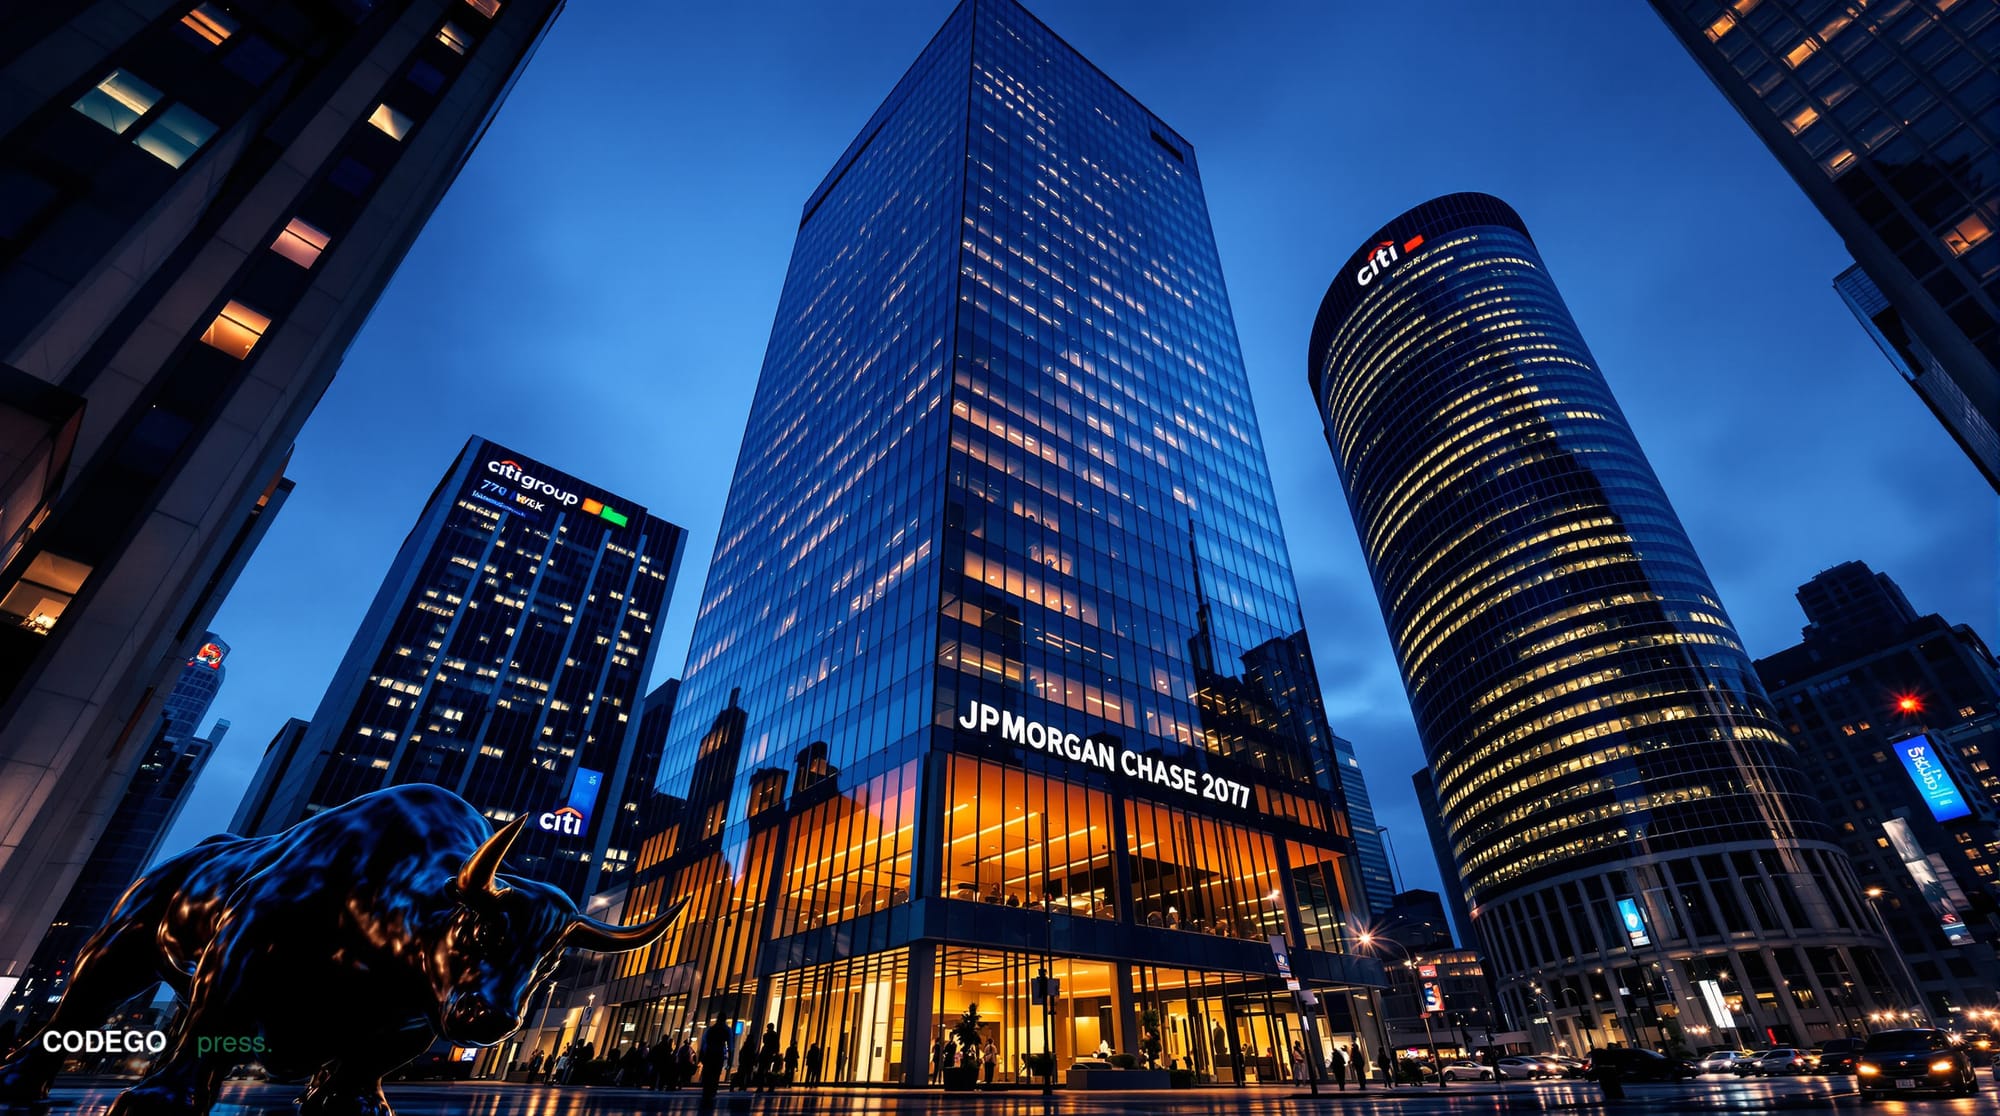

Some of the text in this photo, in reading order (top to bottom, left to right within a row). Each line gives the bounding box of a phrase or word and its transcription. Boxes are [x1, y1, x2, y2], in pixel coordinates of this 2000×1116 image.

[1357, 241, 1398, 286] citi
[487, 460, 579, 506] citigroup
[959, 700, 1250, 809] JPMORGAN CHASE 2077
[539, 807, 583, 835] citi
